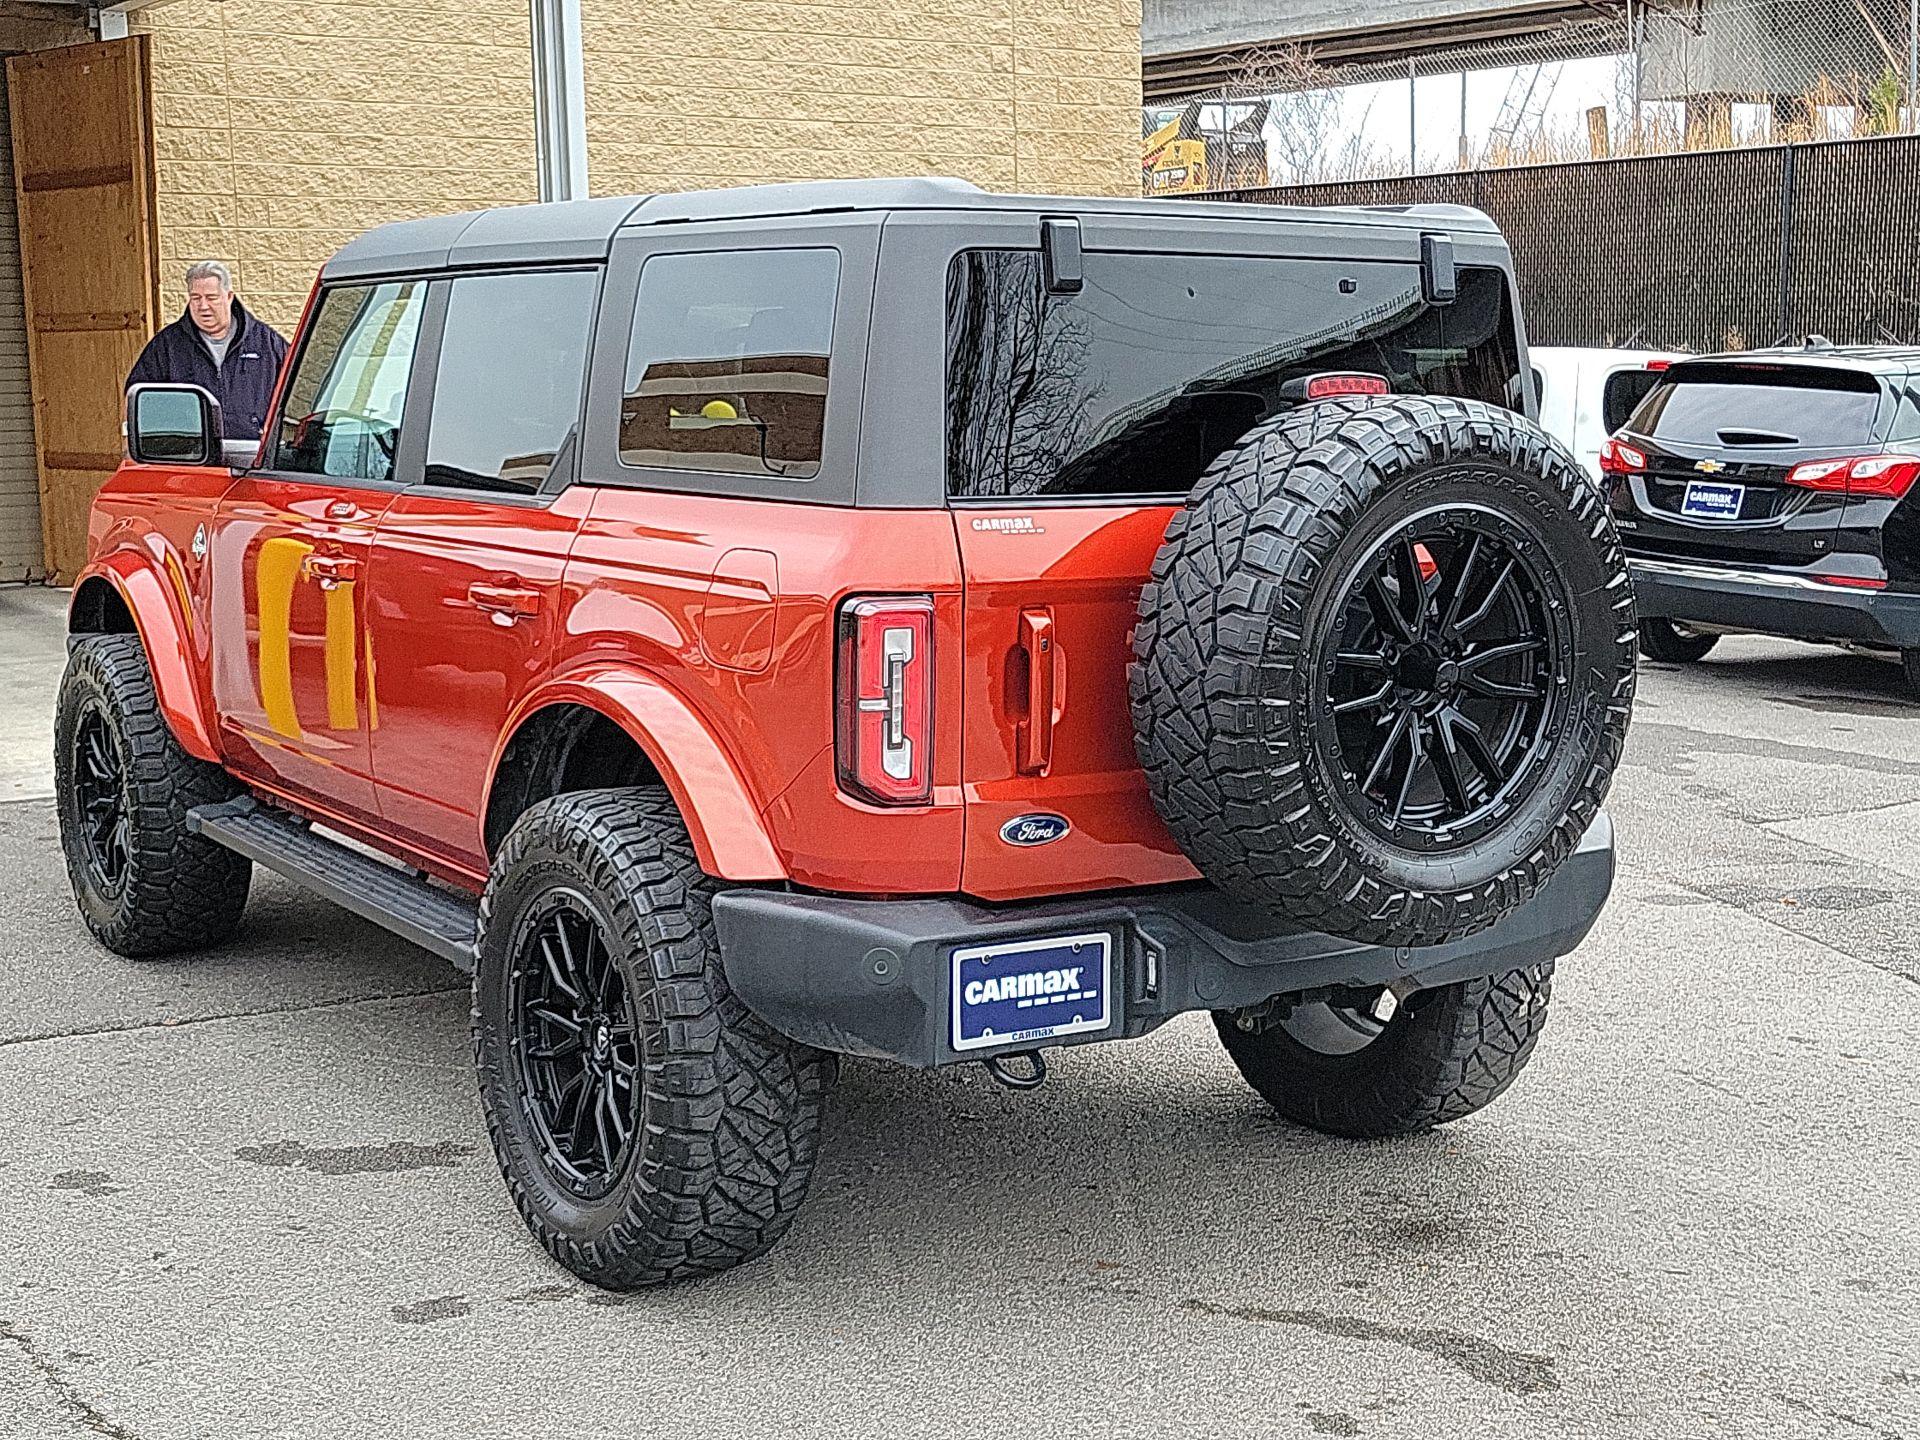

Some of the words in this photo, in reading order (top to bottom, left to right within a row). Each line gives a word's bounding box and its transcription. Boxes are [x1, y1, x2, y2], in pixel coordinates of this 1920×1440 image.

[1814, 539, 1825, 549] LT
[1017, 820, 1055, 841] Ford
[964, 966, 1081, 1006] CARmax
